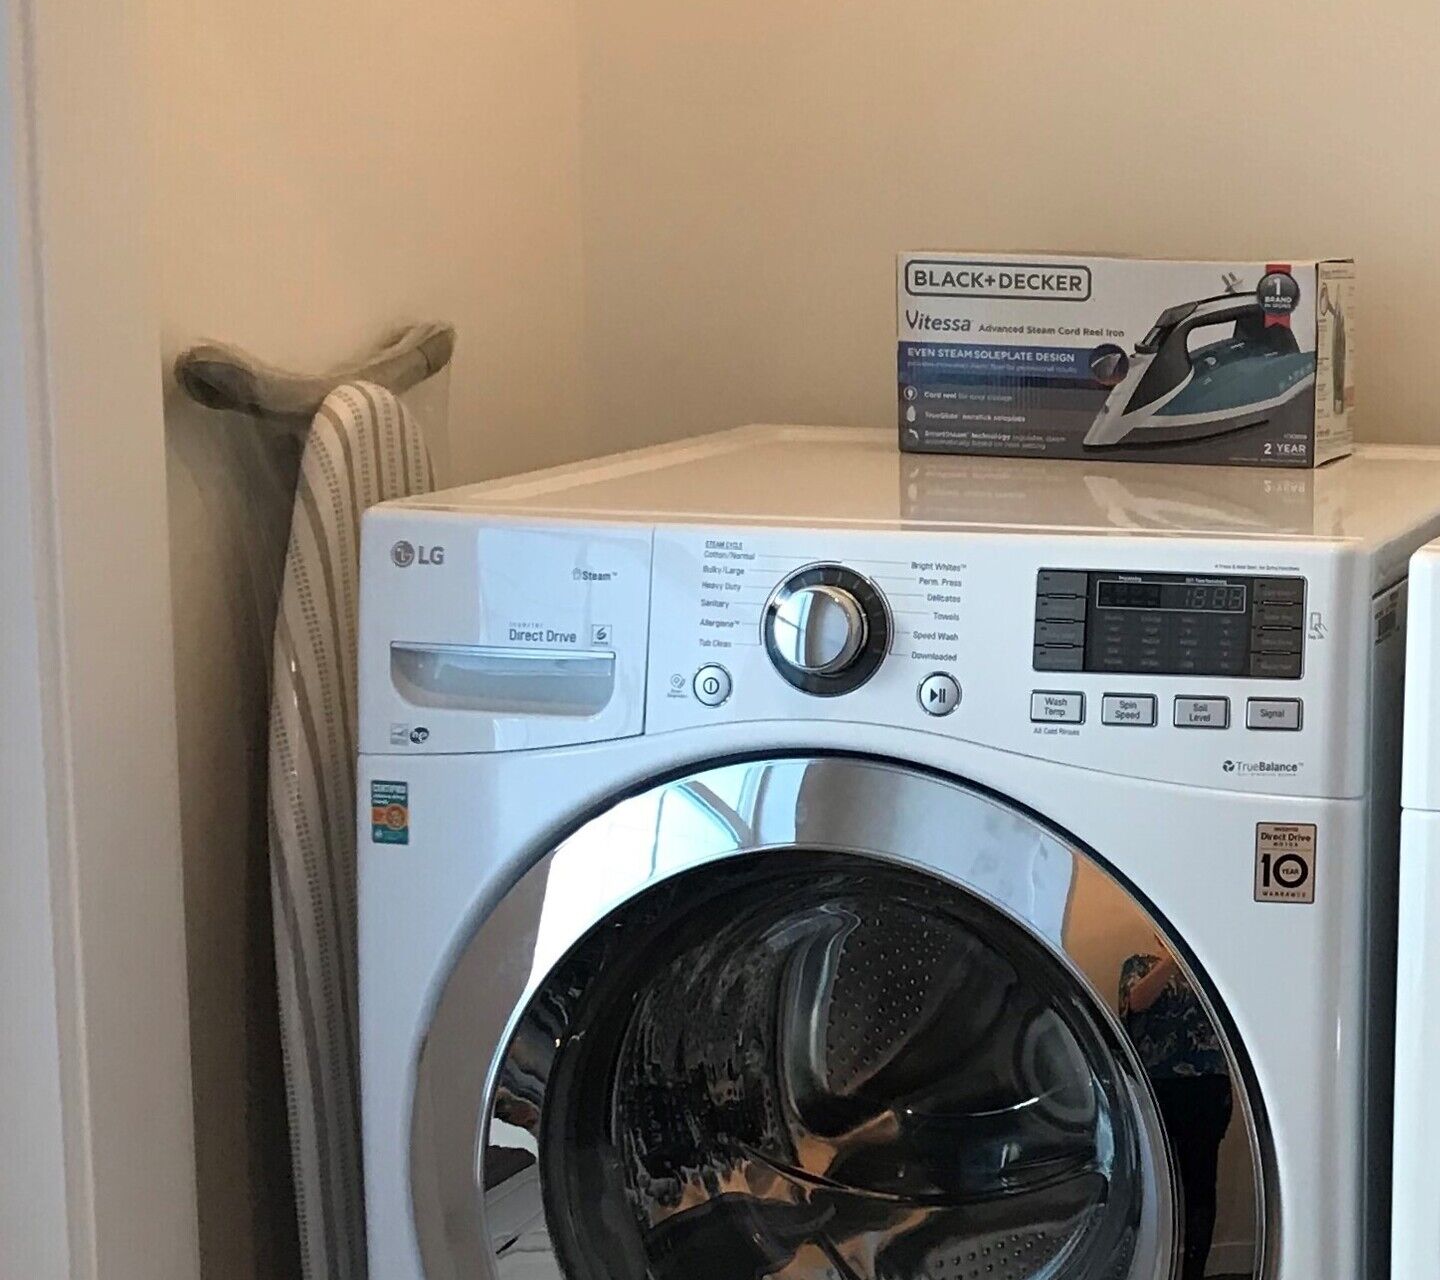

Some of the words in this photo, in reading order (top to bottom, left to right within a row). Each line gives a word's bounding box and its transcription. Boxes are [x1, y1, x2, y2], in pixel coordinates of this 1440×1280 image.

[913, 269, 1083, 292] BLACK+DECKER
[905, 308, 972, 332] Vitessa
[978, 324, 1024, 335] Advanced
[1027, 325, 1055, 335] Steam
[1058, 326, 1080, 336] Cord
[907, 348, 935, 358] EVEN
[937, 349, 974, 359] STEAM
[974, 351, 1034, 362] SOLEPLATE
[1035, 352, 1076, 363] DESIGN
[1263, 442, 1272, 455] 2
[1276, 443, 1307, 454] YEAR
[418, 546, 444, 566] LG
[509, 628, 543, 642] Direct
[546, 629, 577, 643] Drive
[1044, 696, 1067, 707] Wash
[1260, 707, 1285, 720] Signal
[1235, 761, 1298, 773] TrueBalance
[1260, 832, 1286, 841] Direct
[1288, 833, 1311, 842] Drive
[1260, 853, 1309, 889] 10
